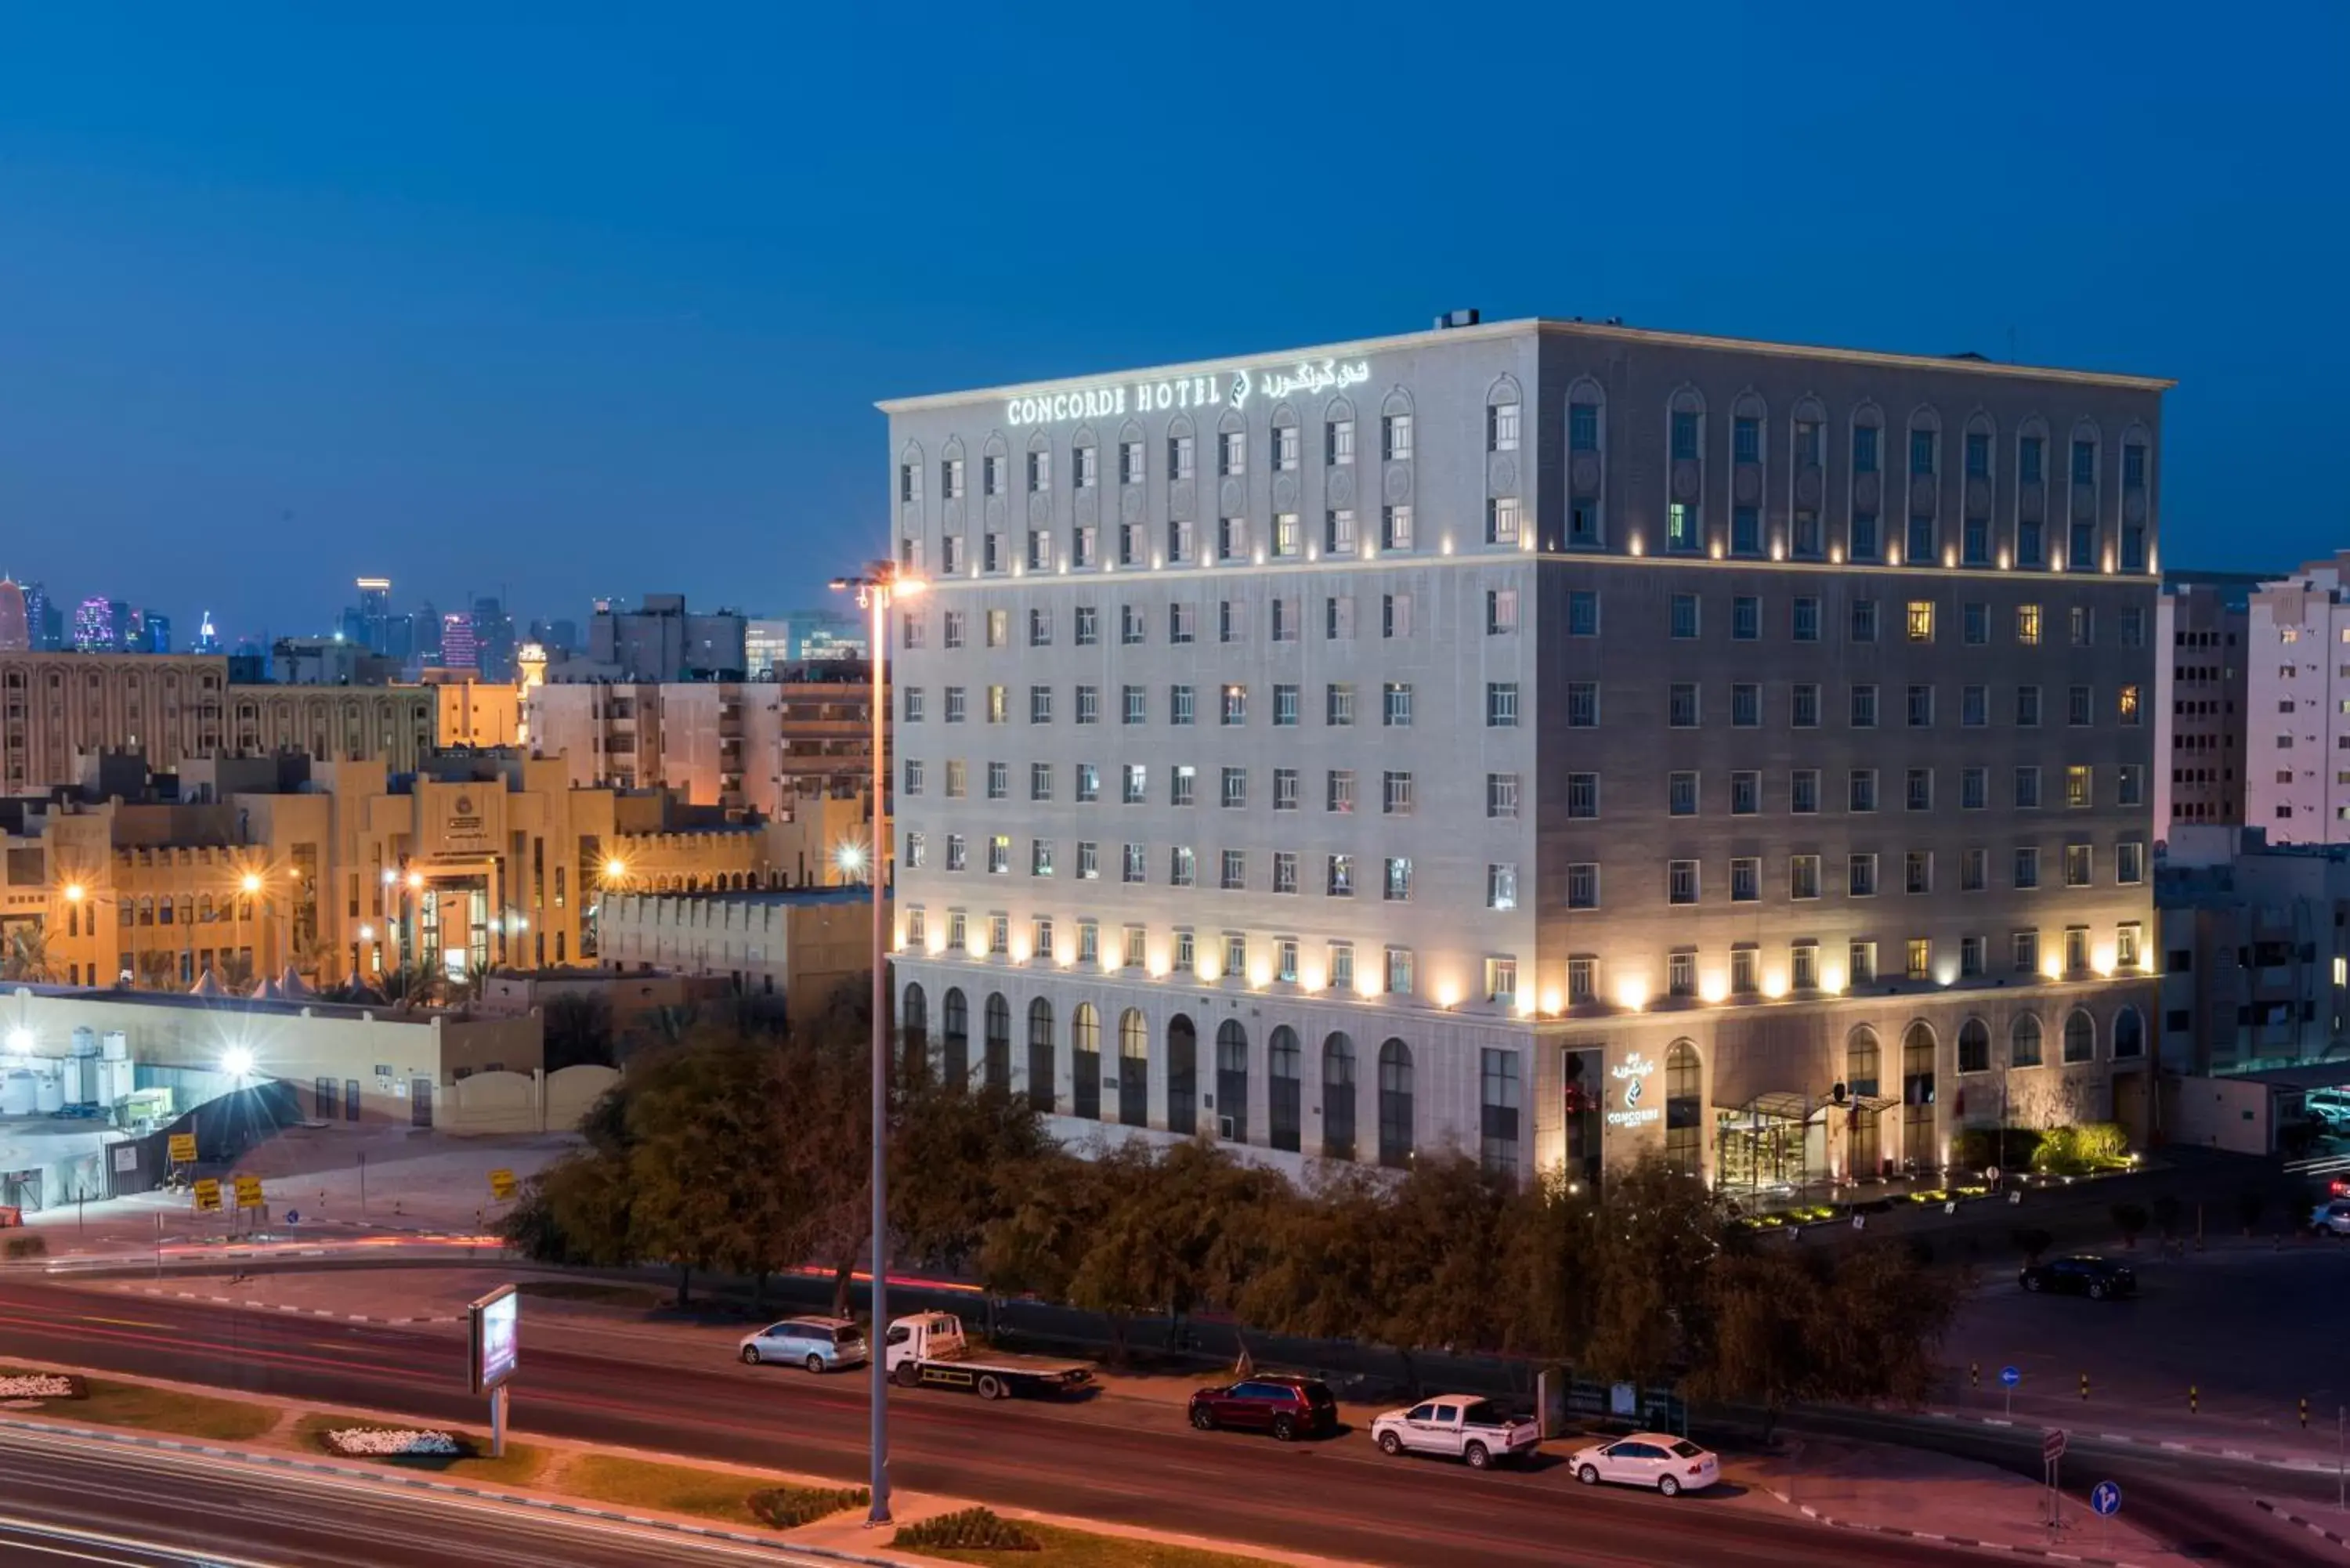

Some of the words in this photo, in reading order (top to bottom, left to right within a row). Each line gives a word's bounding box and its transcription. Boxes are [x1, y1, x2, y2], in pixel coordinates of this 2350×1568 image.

[1337, 361, 1369, 388] فندق
[1008, 388, 1126, 425] CONCORDE
[1137, 376, 1220, 412] HOTEL
[1607, 1108, 1658, 1124] CONCO
